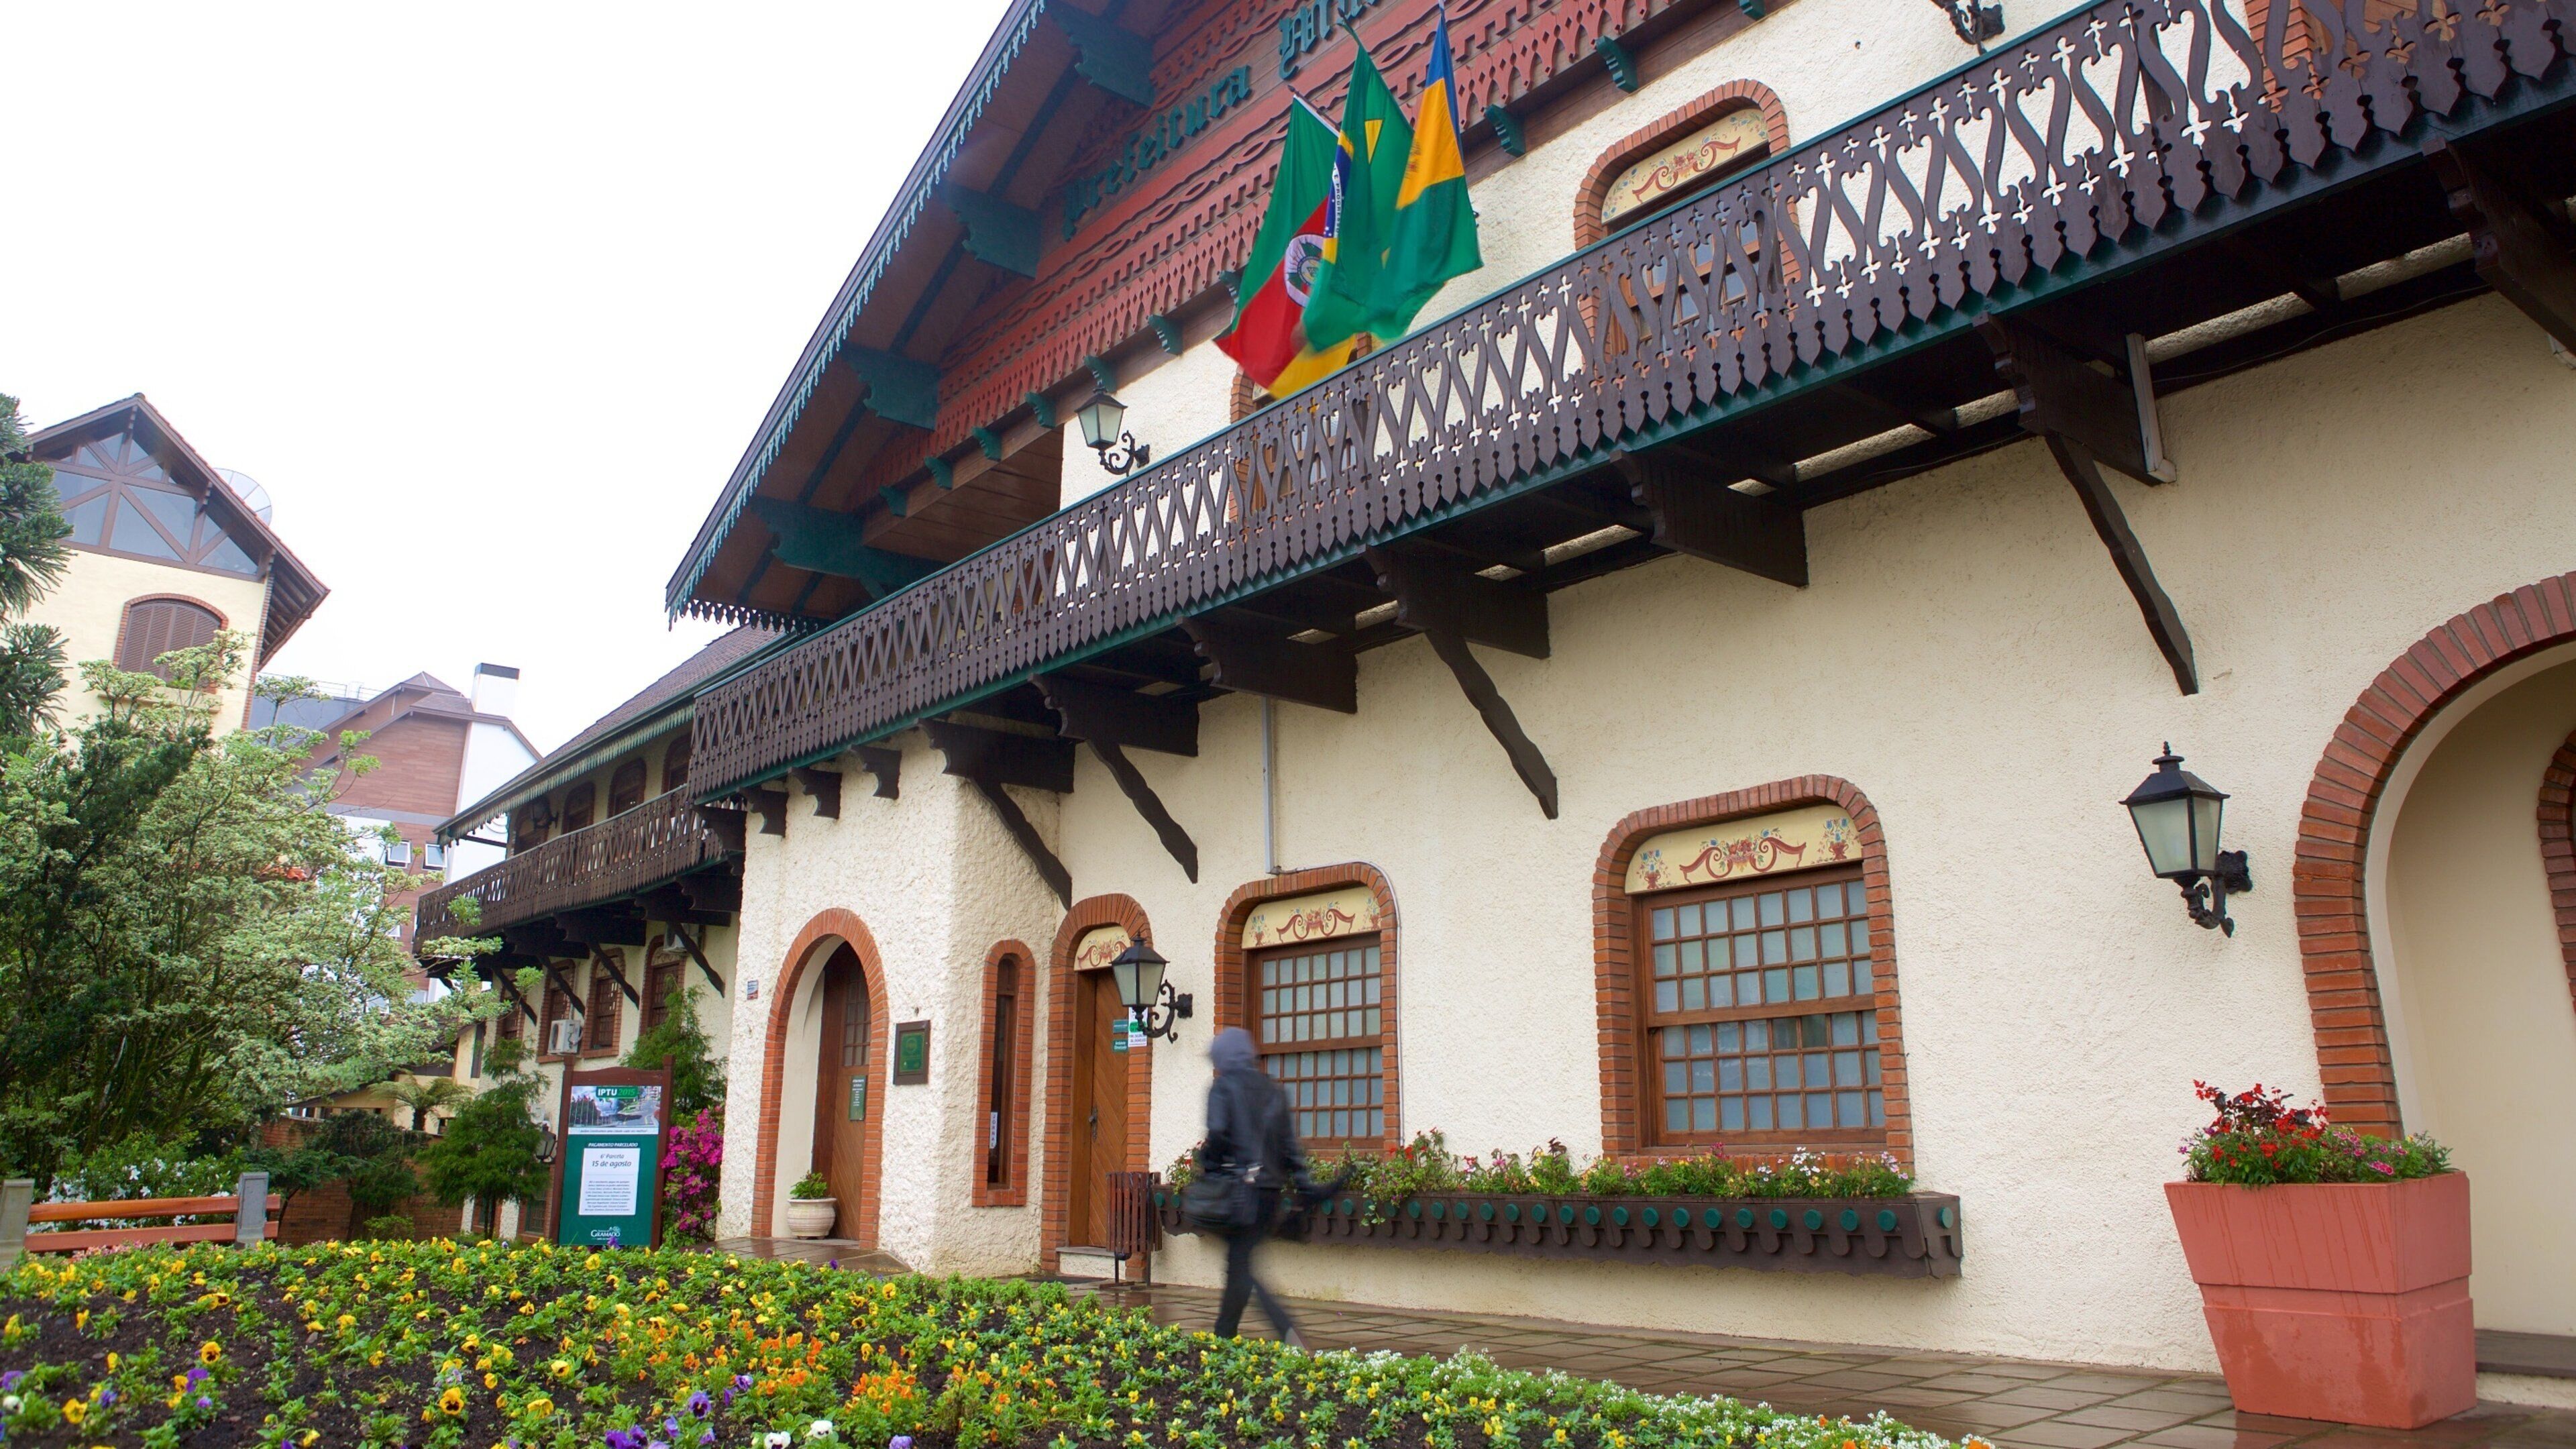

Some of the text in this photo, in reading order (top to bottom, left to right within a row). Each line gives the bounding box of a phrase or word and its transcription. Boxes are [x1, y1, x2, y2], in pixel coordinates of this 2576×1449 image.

[1061, 64, 1252, 241] Prefeitura
[598, 1088, 635, 1096] IPTU 2015
